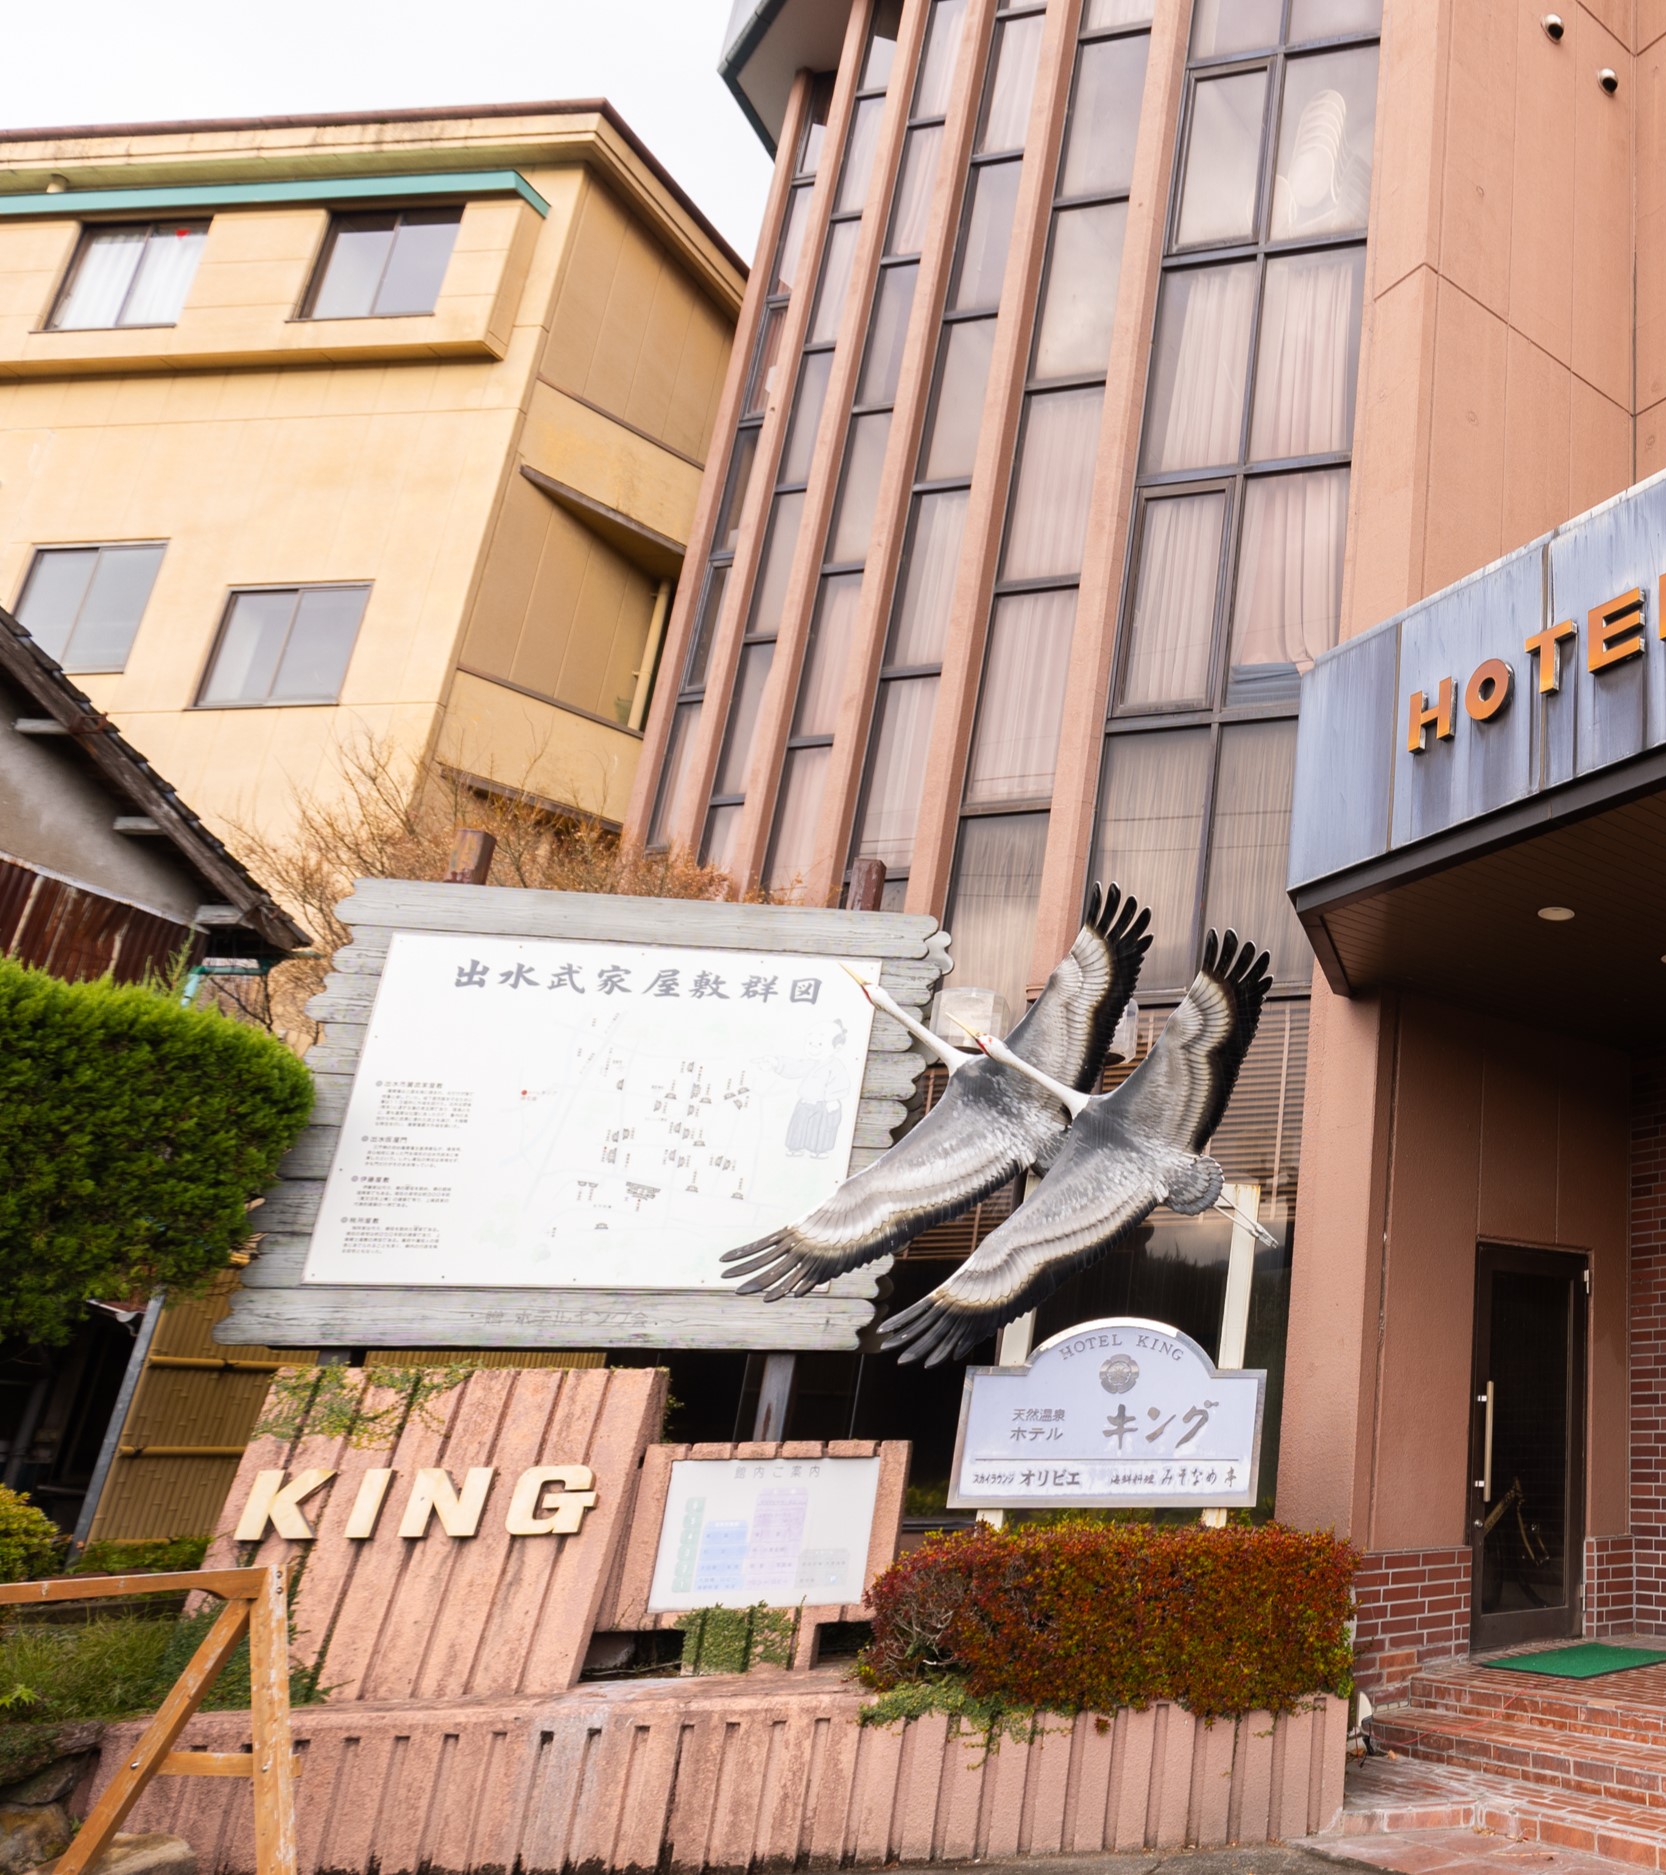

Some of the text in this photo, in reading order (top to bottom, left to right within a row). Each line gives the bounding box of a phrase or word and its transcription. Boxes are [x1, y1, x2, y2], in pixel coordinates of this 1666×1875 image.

[454, 959, 822, 1005] 出水武家屋敷群図
[1059, 1333, 1185, 1362] HOTEL KING
[1011, 1408, 1066, 1422] 天然温泉
[1102, 1399, 1219, 1450] キング
[1010, 1426, 1064, 1442] ホテル
[733, 1465, 821, 1480] 館内ご案内
[233, 1464, 599, 1541] KING
